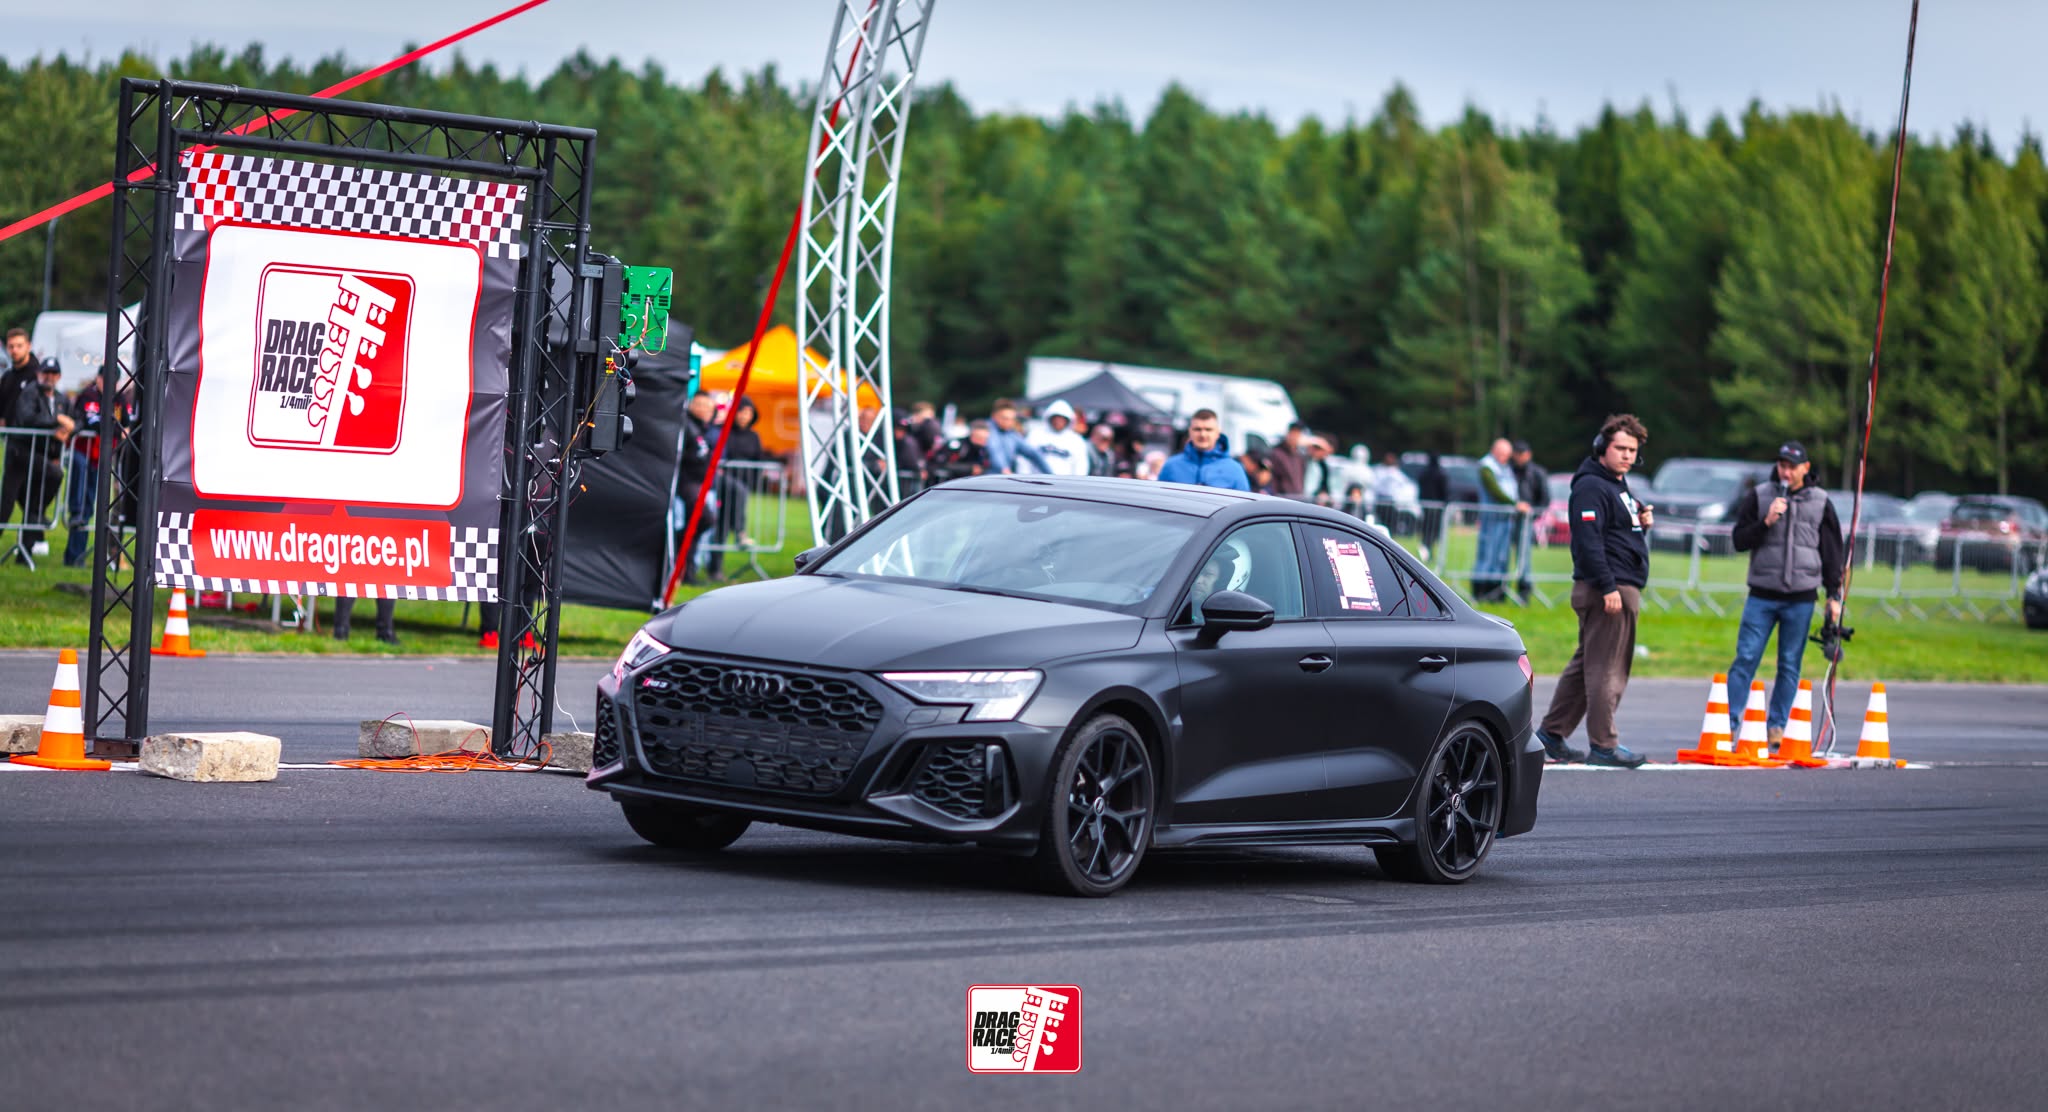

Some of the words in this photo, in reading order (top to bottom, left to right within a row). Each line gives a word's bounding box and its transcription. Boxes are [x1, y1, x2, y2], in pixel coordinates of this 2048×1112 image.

[263, 319, 326, 356] DRAG
[259, 354, 319, 394] RACE
[209, 522, 431, 577] www.dragrace.pl
